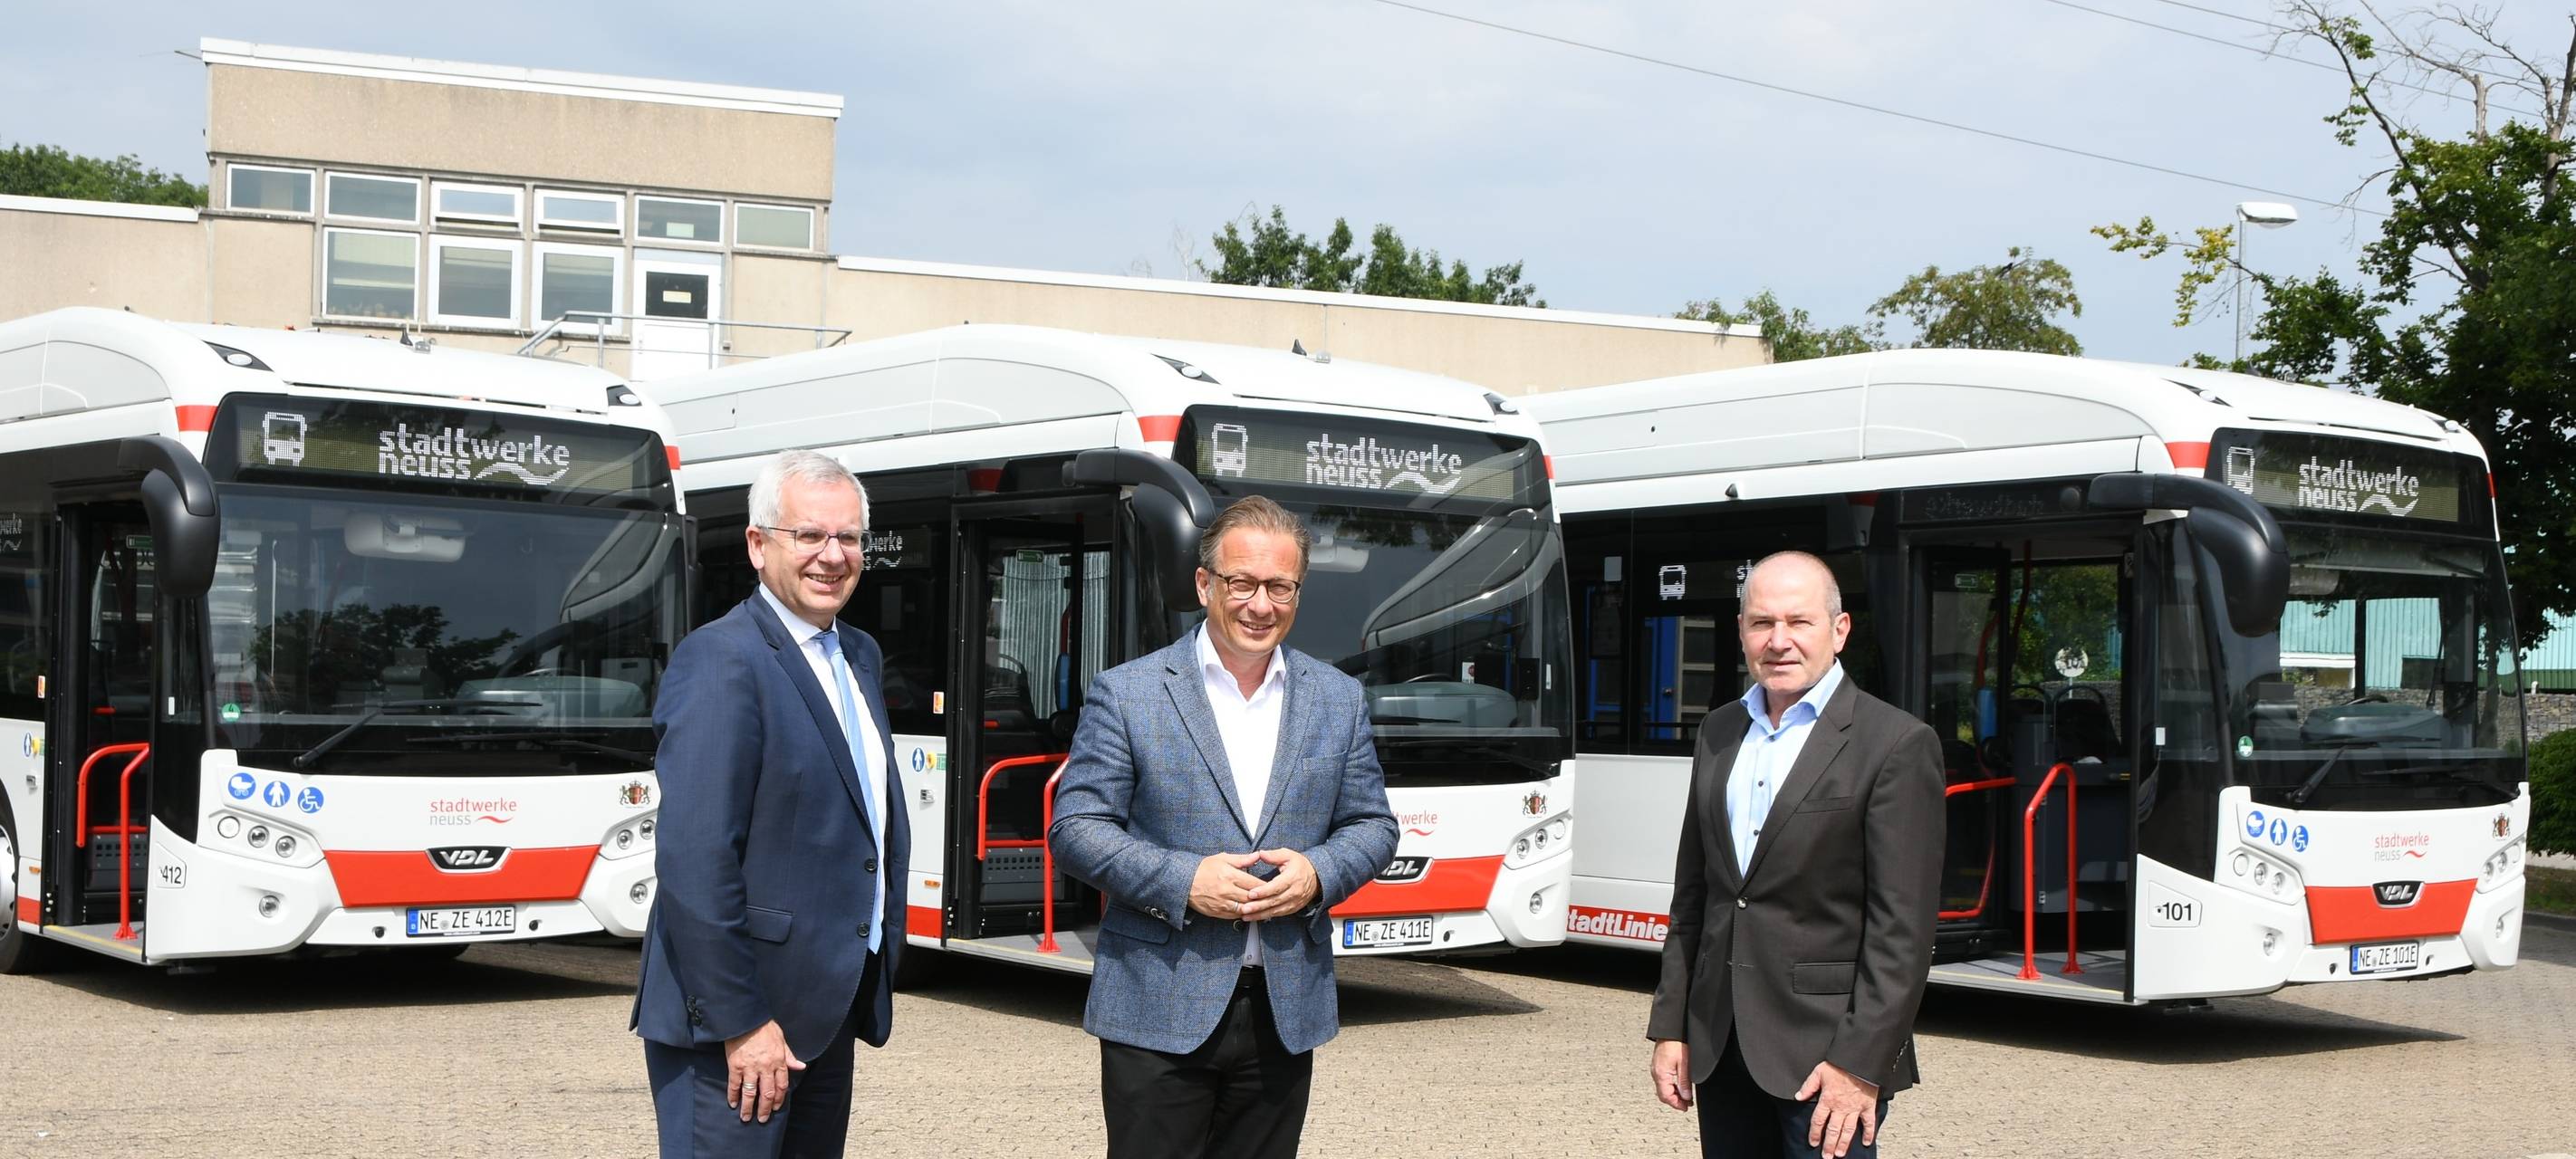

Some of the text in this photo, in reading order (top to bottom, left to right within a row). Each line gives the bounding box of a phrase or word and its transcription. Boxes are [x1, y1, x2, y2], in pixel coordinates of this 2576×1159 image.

[379, 423, 570, 466] stadtwerke
[1306, 434, 1462, 474] stadtwerke
[379, 452, 472, 479] neuss
[2299, 455, 2419, 497] stadtwerke
[1306, 463, 1382, 490] neuss
[2299, 486, 2358, 512] neuss
[430, 797, 517, 813] stadtwerke
[429, 814, 472, 826] neuss
[2374, 831, 2430, 849] stadtwerke
[439, 850, 495, 866] VDL
[2374, 848, 2401, 862] neuss
[162, 865, 182, 885] 412
[2379, 885, 2414, 901] VDL
[419, 909, 512, 930] NE ZE 412E
[2162, 902, 2192, 921] 101
[1354, 920, 1430, 941] NE ZE 411E
[1567, 908, 1668, 941] tadtLinie
[2360, 945, 2417, 968] NE ZE 101E
